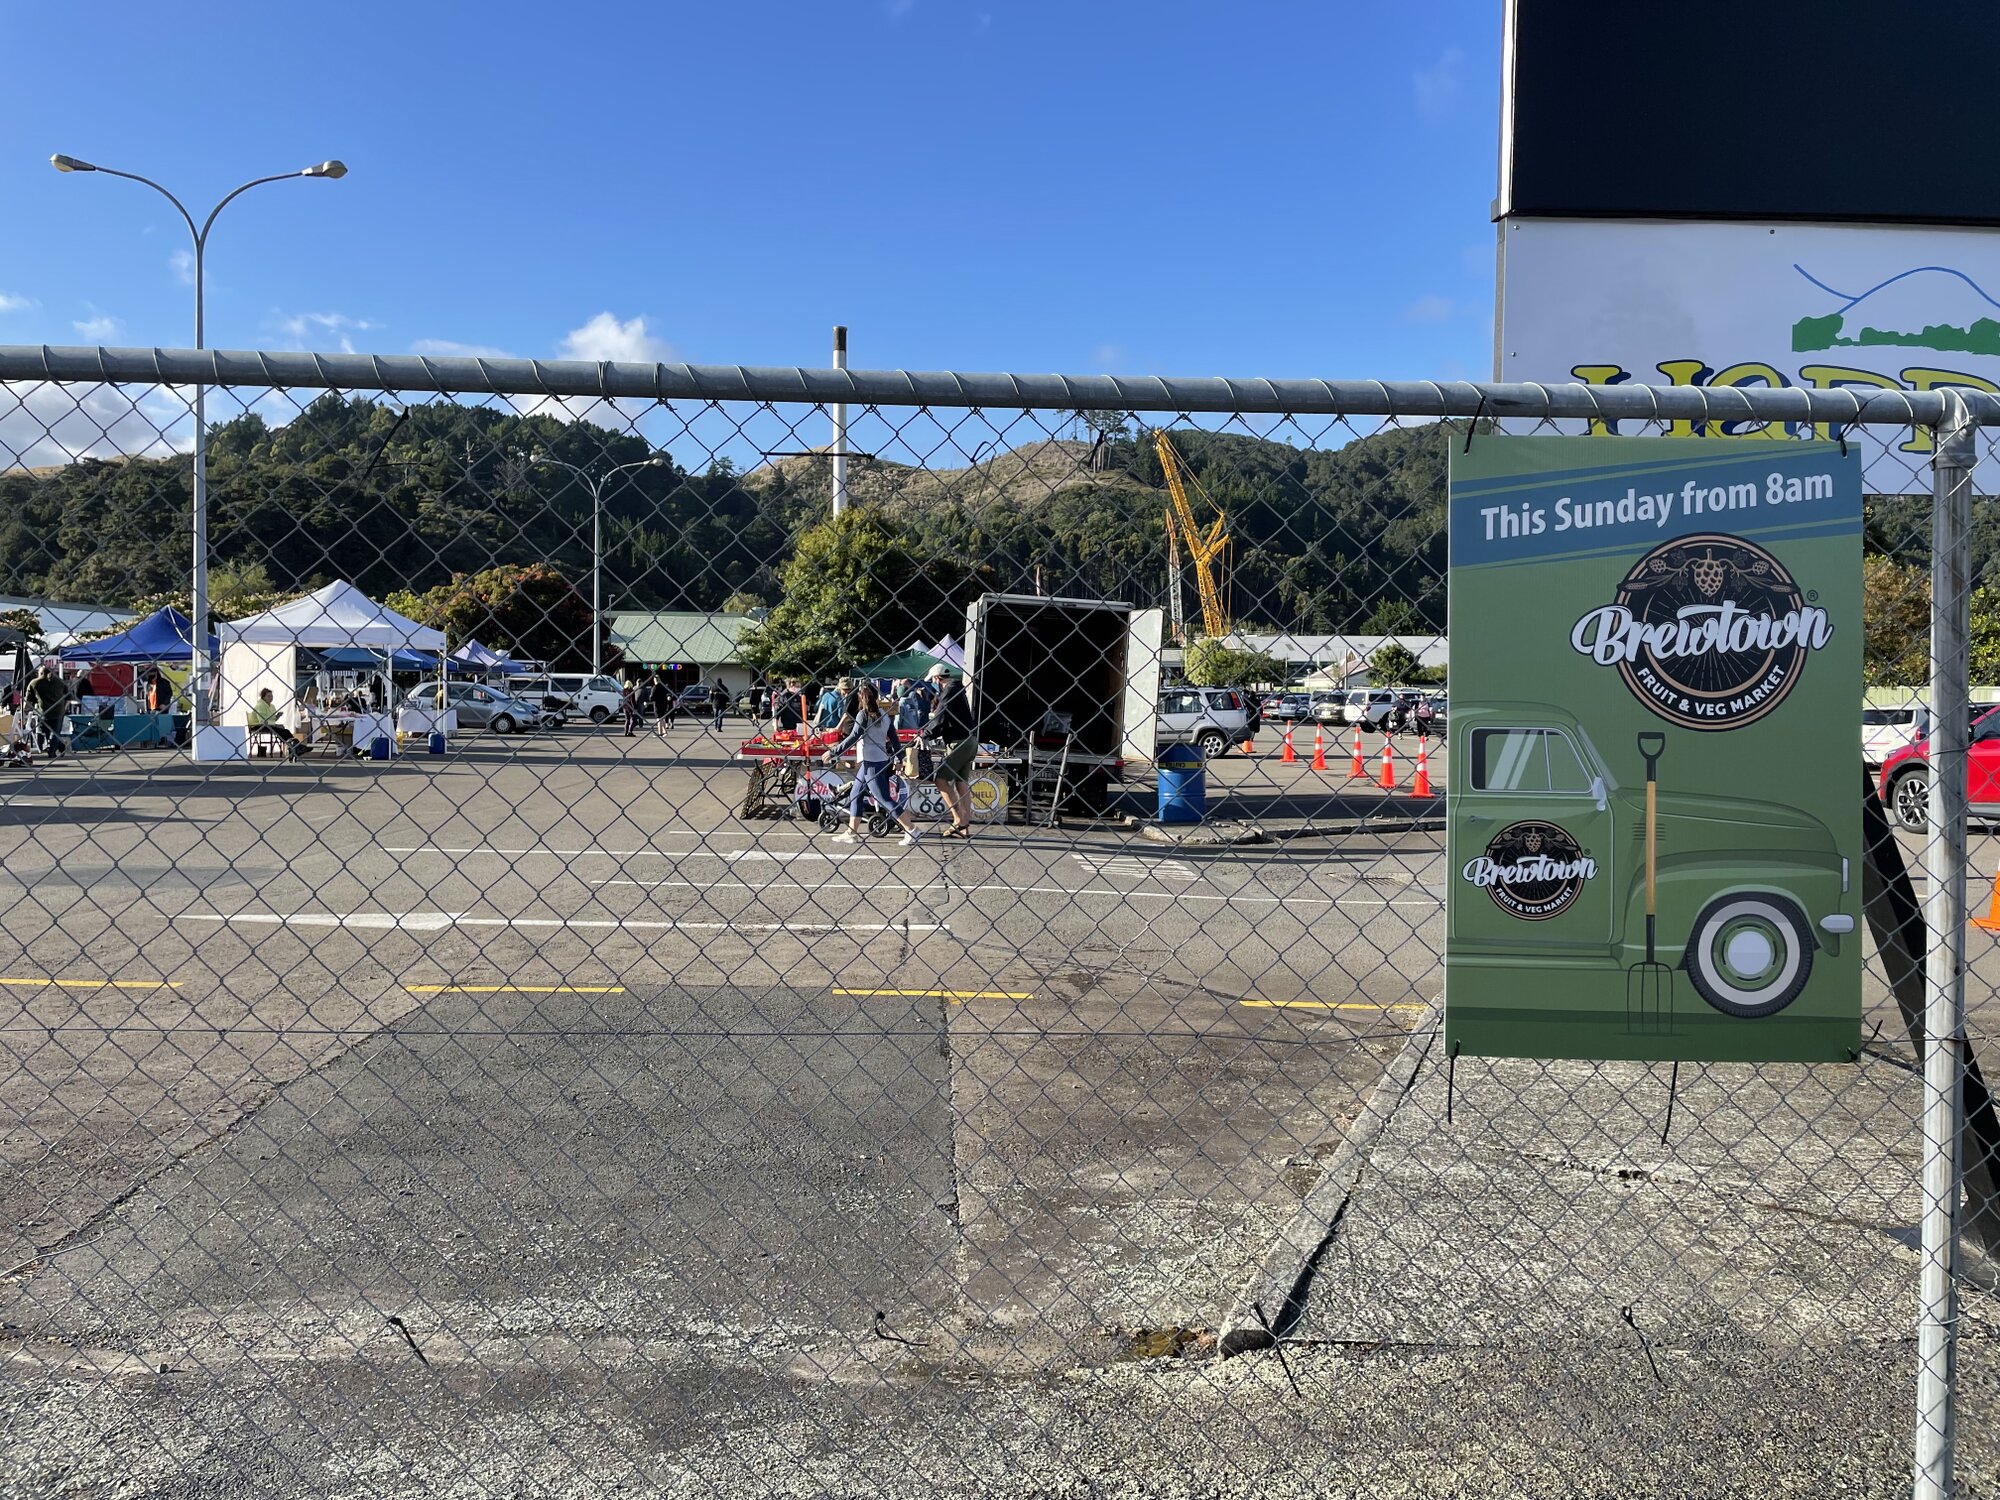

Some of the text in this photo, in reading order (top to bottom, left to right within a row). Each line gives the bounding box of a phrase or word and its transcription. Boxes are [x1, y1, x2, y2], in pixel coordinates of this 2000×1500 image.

[1480, 472, 1833, 541] This Sunday from 8am
[1570, 600, 1834, 666] Brewtown
[1637, 664, 1786, 716] FRUIT & VEG MARKET
[920, 797, 946, 814] 66
[1462, 854, 1599, 888] Brewtown
[1495, 886, 1574, 914] FRUIT & VEG MARKET
